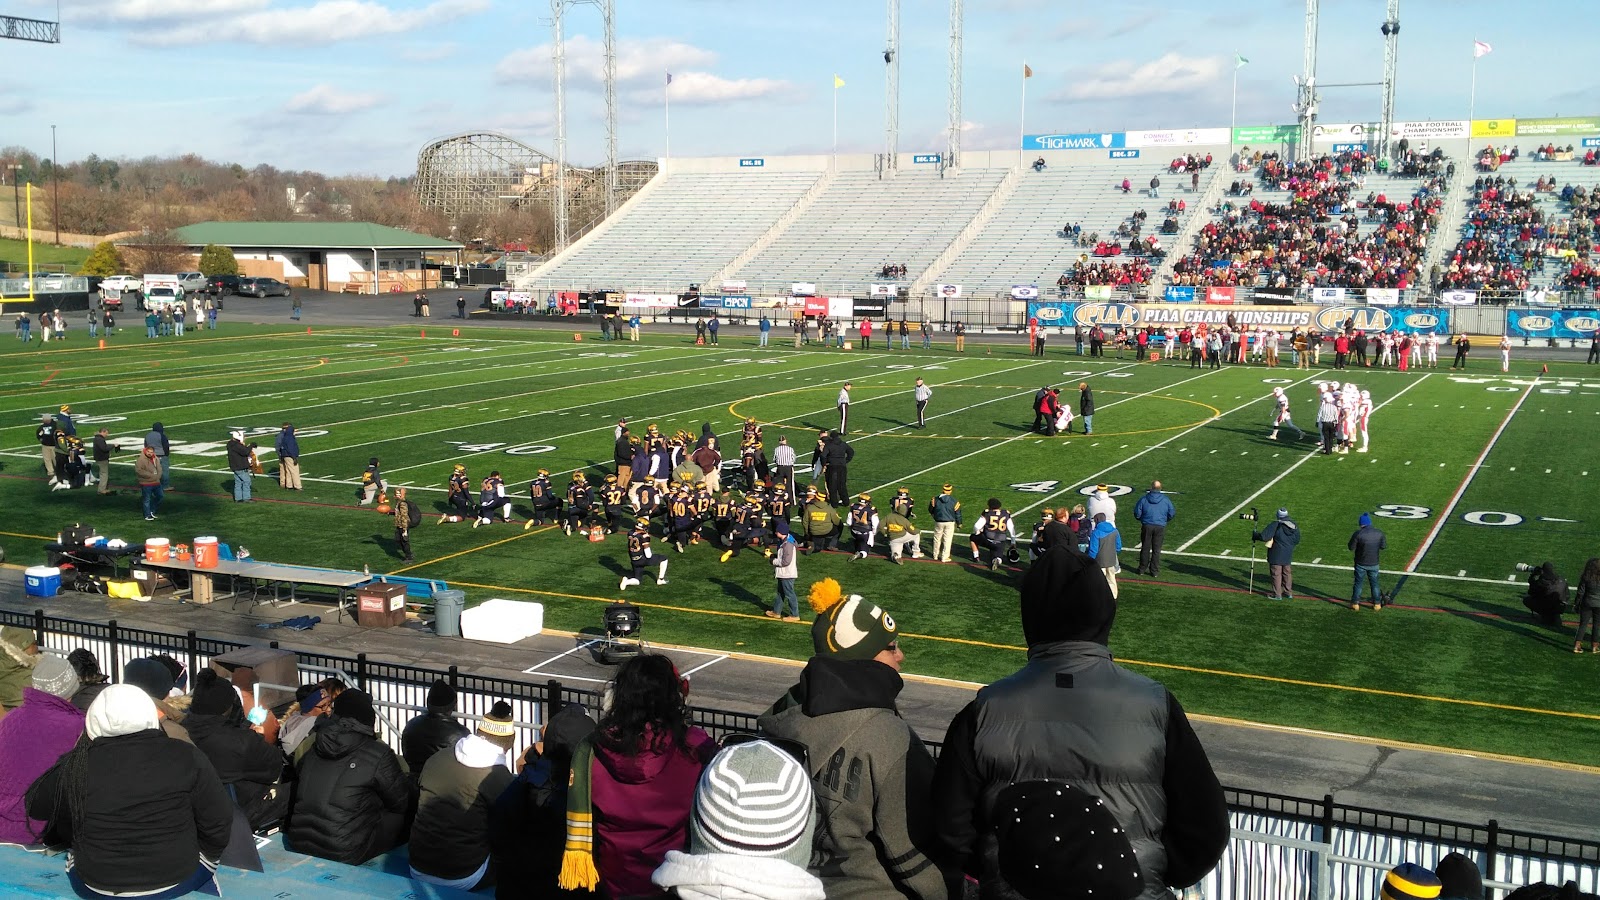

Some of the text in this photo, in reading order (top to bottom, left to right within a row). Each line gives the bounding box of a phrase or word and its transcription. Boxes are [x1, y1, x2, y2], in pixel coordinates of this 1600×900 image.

[1036, 135, 1098, 149] HIGHMARK
[733, 298, 749, 307] PCN
[1083, 307, 1136, 325] PIAA
[1144, 309, 1180, 323] PIAA
[606, 491, 621, 505] 32
[697, 498, 710, 513] 13
[672, 502, 686, 517] 40
[717, 504, 729, 517] 17
[852, 509, 868, 525] 54
[1374, 504, 1523, 526] 30
[989, 515, 1007, 532] 56
